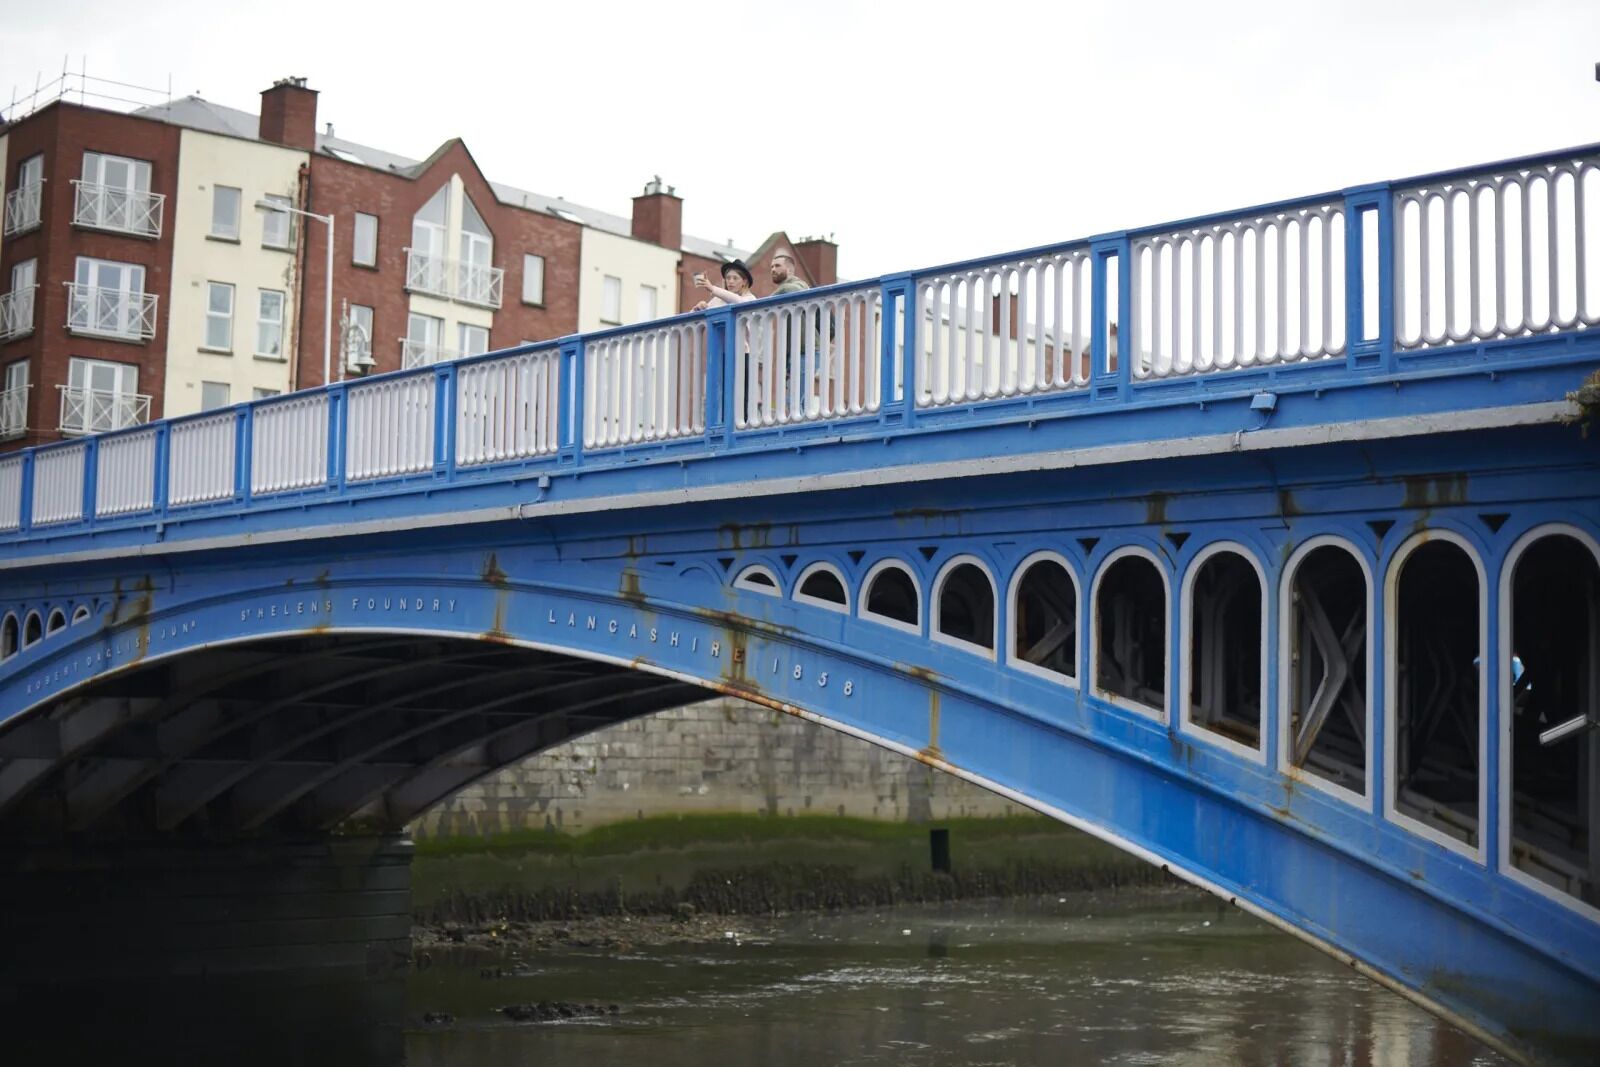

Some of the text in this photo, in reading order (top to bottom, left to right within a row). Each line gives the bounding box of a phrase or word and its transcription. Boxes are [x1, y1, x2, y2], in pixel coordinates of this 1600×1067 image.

[352, 598, 457, 611] FOUNDRY
[549, 609, 745, 663] LANCASHIRE
[773, 658, 855, 696] 1858
